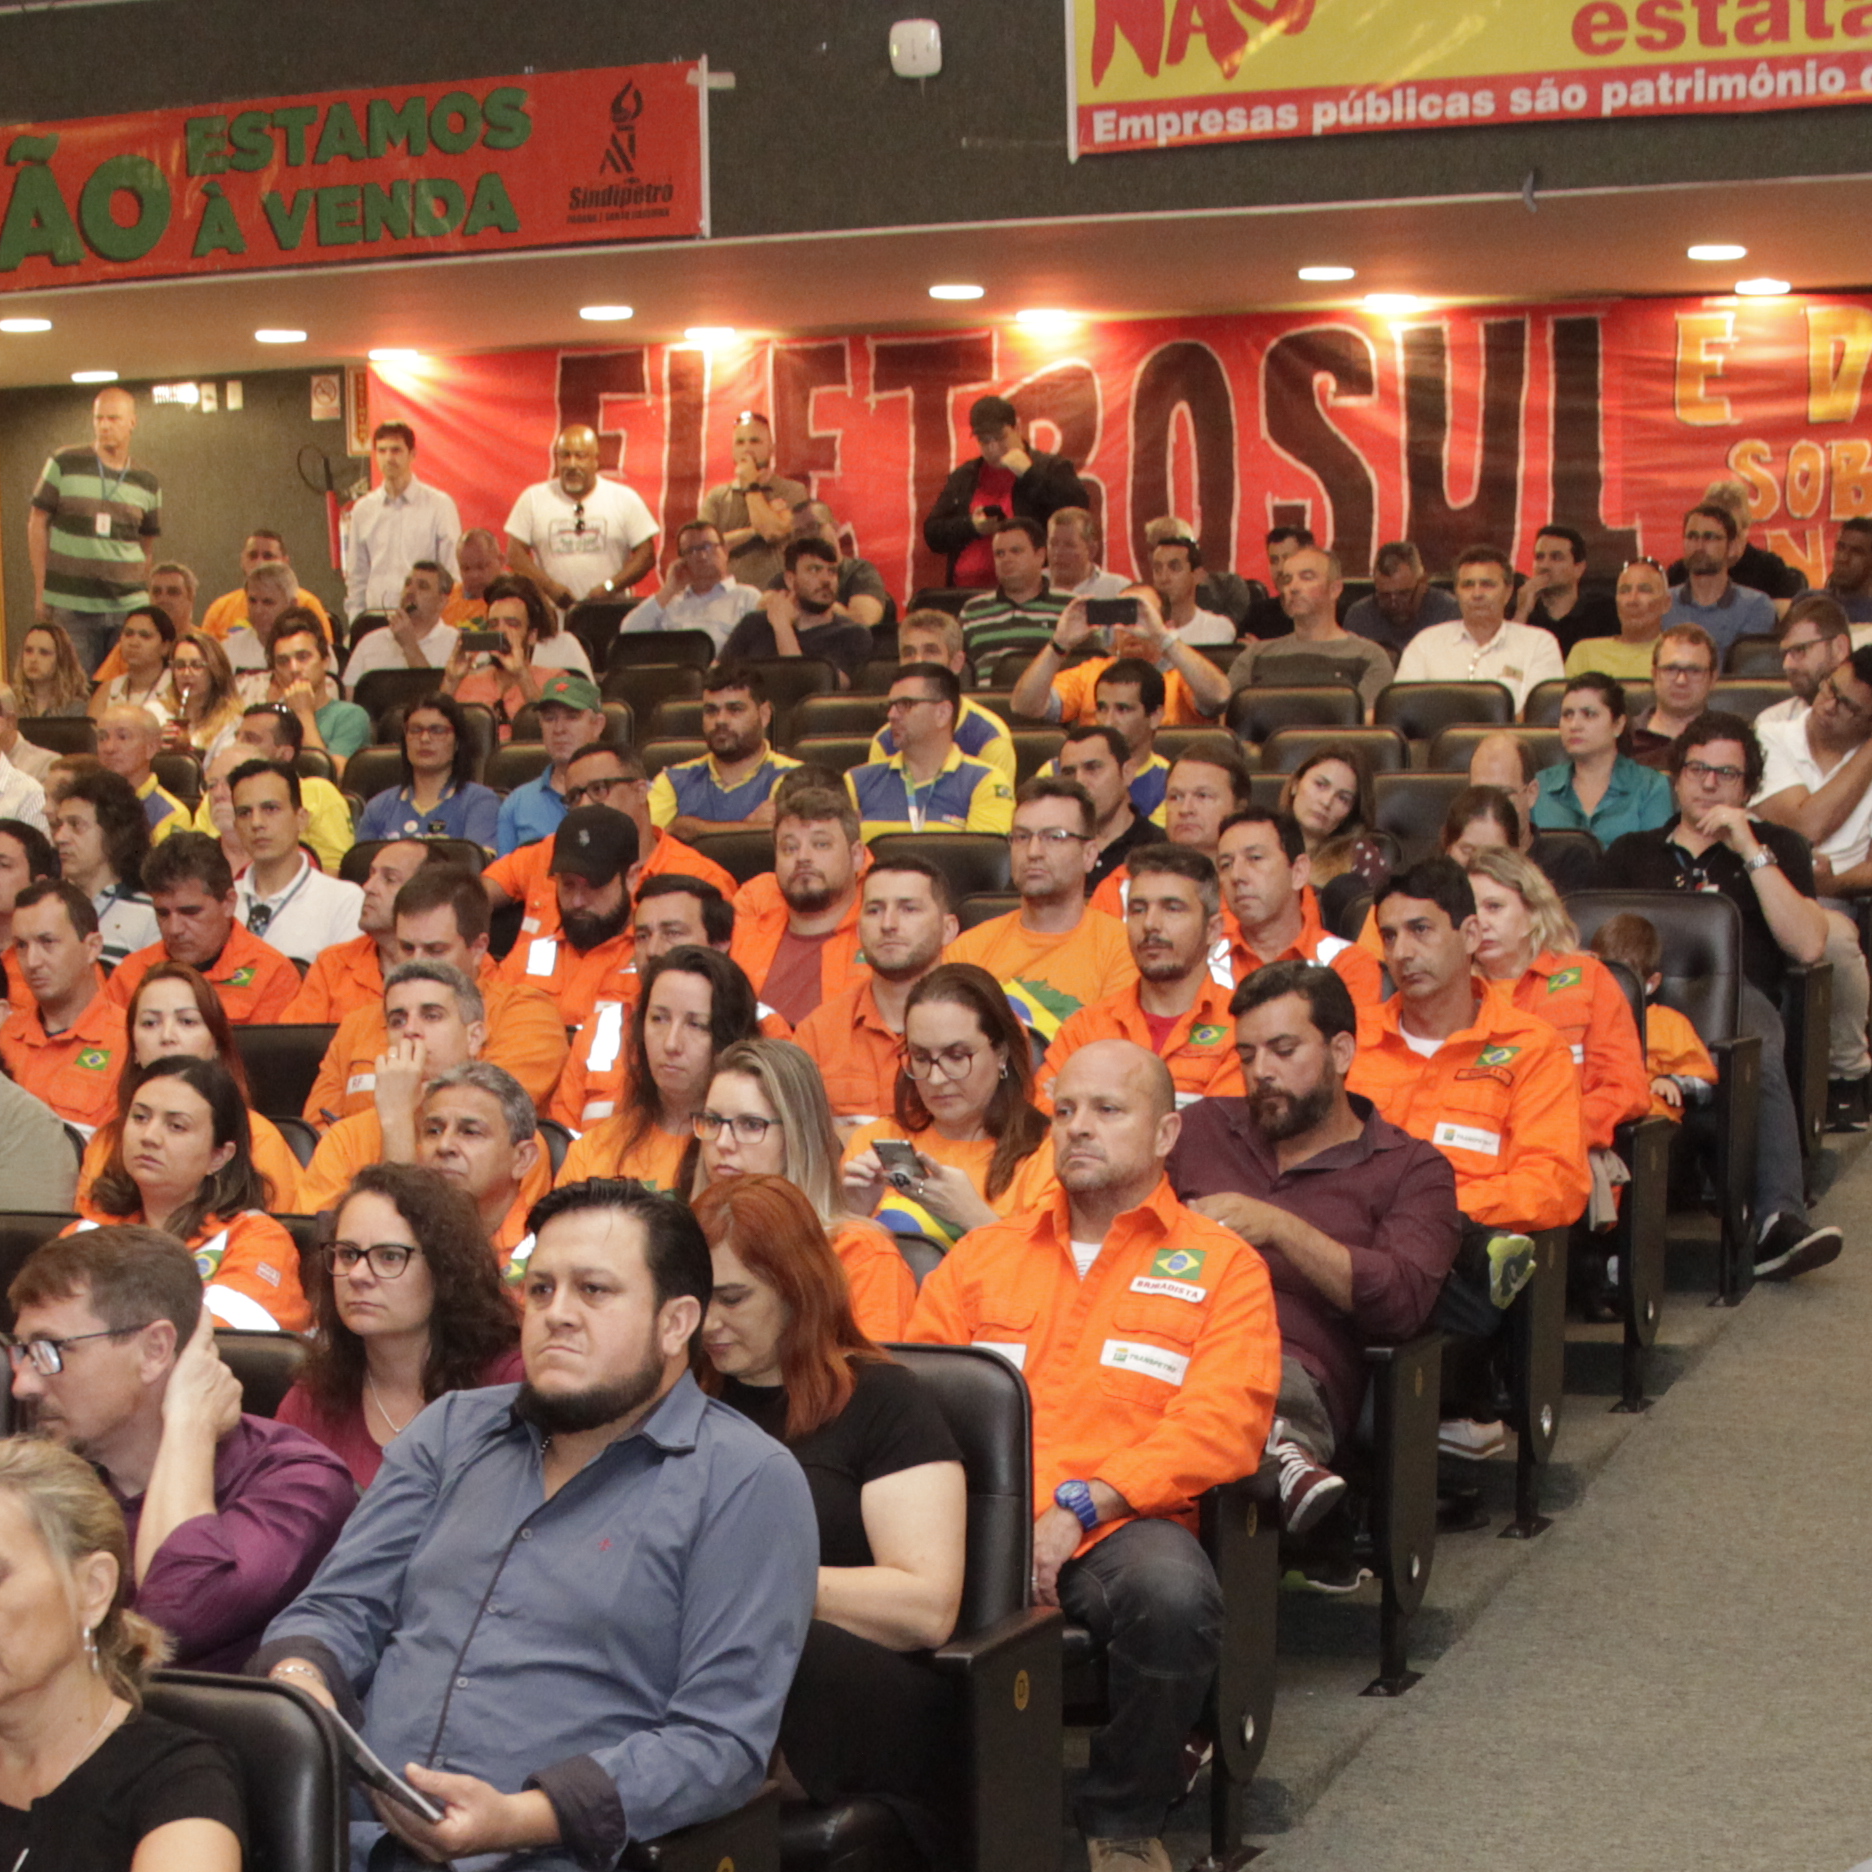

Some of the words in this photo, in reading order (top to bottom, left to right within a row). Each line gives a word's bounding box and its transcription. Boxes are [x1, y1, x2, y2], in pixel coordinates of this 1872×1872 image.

[185, 87, 532, 177] ESTAMOS
[1092, 103, 1298, 146] Empresas
[1312, 88, 1495, 135] públicas
[1510, 77, 1587, 114] são
[1602, 52, 1845, 117] patrimônio
[192, 181, 247, 258] À
[262, 173, 521, 250] VENDA
[1136, 1280, 1199, 1299] BRIGADISTA
